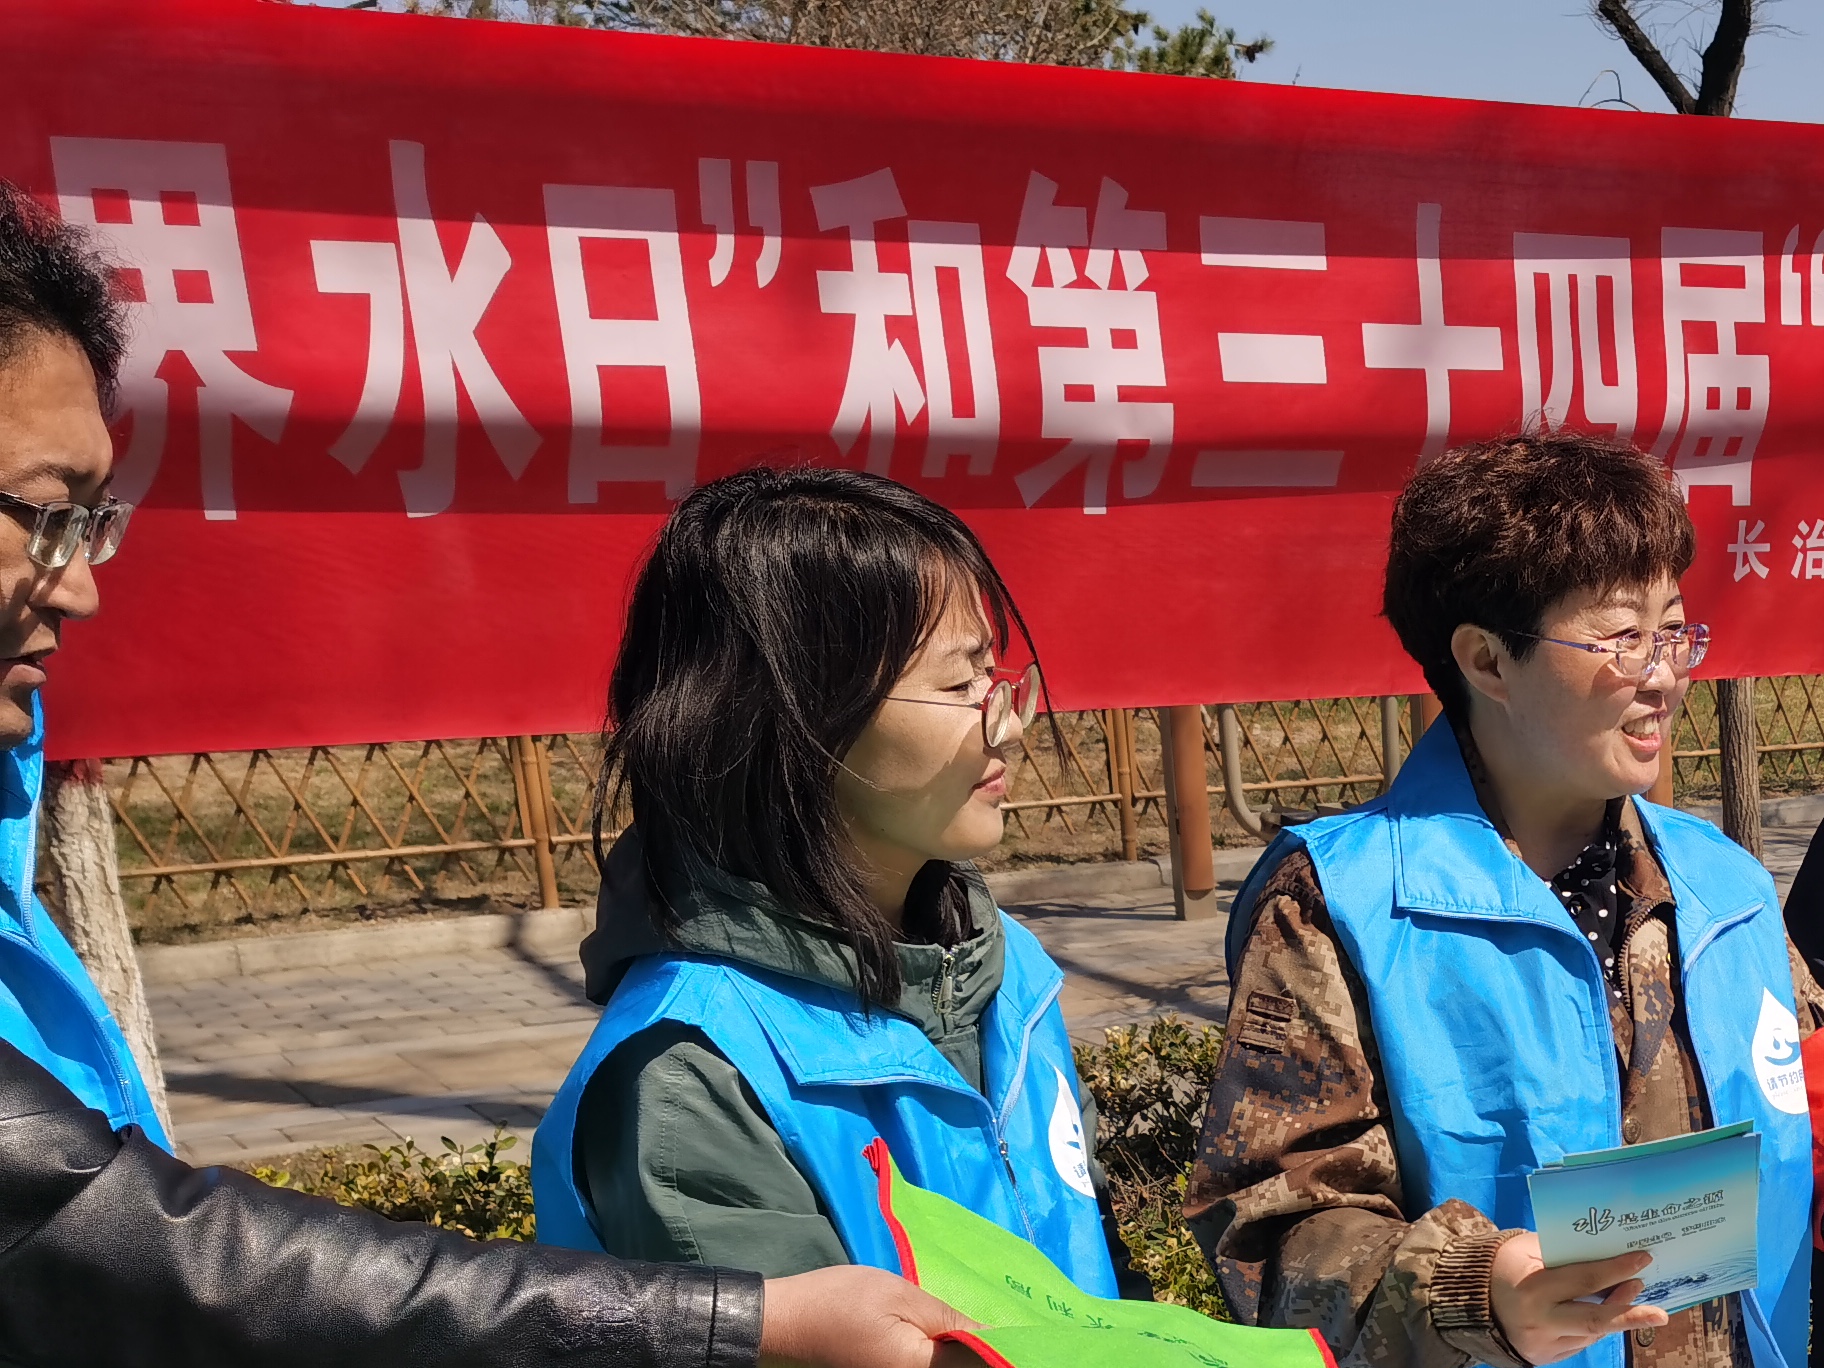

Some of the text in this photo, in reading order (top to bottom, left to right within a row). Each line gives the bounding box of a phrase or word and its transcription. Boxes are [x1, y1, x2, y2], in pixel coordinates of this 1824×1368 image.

[1572, 1189, 1724, 1236] 水是生命之源
